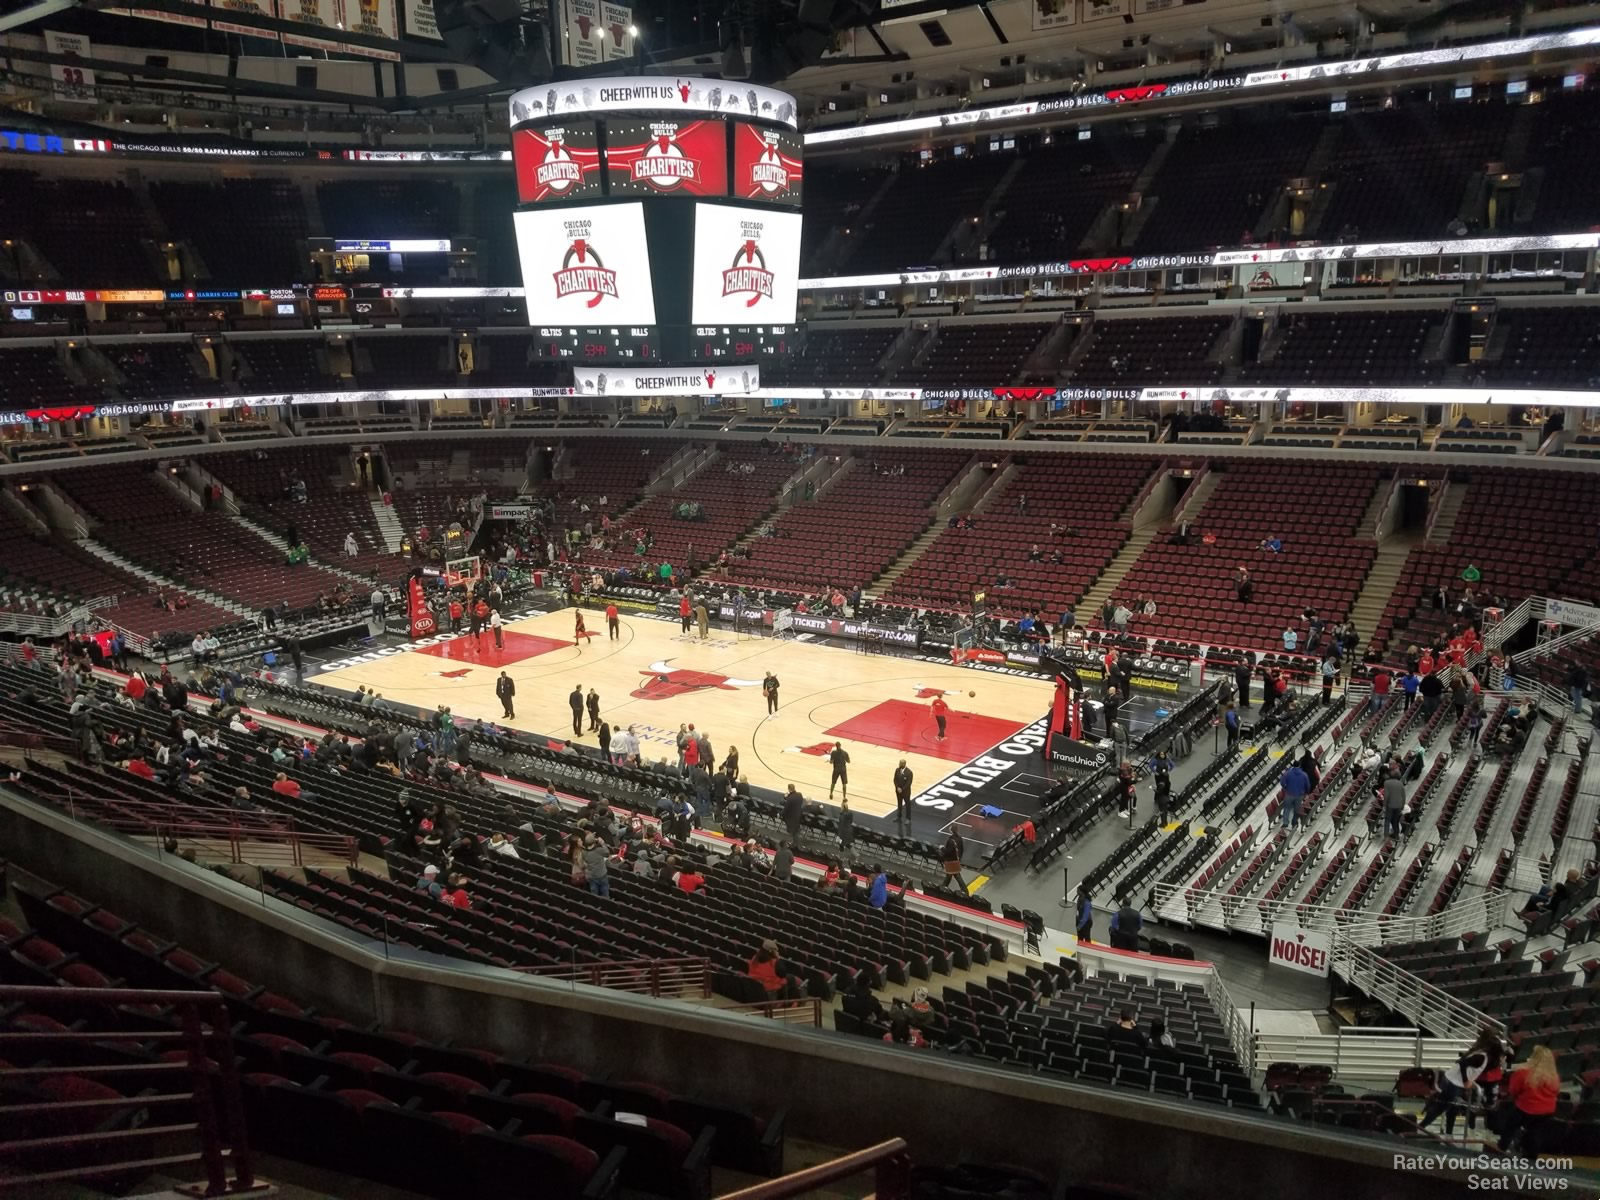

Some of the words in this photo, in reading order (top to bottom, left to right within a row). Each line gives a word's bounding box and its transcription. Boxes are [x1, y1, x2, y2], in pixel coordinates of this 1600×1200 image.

[1172, 81, 1209, 93] CHICAGO
[1212, 77, 1241, 88] BULLS
[600, 87, 632, 102] CHEER
[633, 86, 658, 99] WITH
[660, 86, 673, 99] US
[1040, 100, 1075, 111] CHICAGO
[1077, 95, 1102, 106] BULLS
[127, 144, 160, 152] CHICAGO
[204, 147, 229, 155] RAFFLE
[537, 162, 580, 184] CHARITIES
[635, 158, 694, 178] CHARITIES
[753, 164, 787, 186] CHARITIES
[563, 219, 592, 229] CHICAGO
[740, 220, 764, 231] CHICAGO
[569, 228, 589, 237] BULLS
[743, 229, 759, 238] BULLS
[1137, 256, 1177, 267] CHICAGO
[1180, 255, 1210, 265] BULLS
[1001, 266, 1037, 276] CHICAGO
[1040, 264, 1065, 273] BULLS
[558, 269, 616, 295] CHARITIES
[725, 269, 772, 295] CHARITIES
[66, 291, 86, 301] BULLS
[541, 328, 562, 337] CELTICS
[631, 328, 649, 337] BULLS
[696, 327, 716, 336] CELTICS
[772, 326, 786, 335] BULLS
[635, 377, 665, 390] CHEER
[665, 376, 688, 388] WITH
[690, 375, 702, 387] US
[532, 388, 546, 396] RUN
[546, 388, 559, 396] WITH
[559, 387, 568, 395] US
[925, 390, 960, 399] CHICAGO
[962, 390, 989, 399] BULLS
[1061, 390, 1102, 399] CHICAGO
[1106, 390, 1137, 398] BULLS
[100, 405, 139, 415] CHICAGO
[142, 402, 169, 412] BULLS
[1563, 606, 1598, 619] Advocate
[417, 620, 430, 628] KIA
[794, 617, 826, 629] TICKETS
[1562, 614, 1587, 626] Health
[320, 631, 458, 671] CHICAGO
[1007, 652, 1040, 663] Bulls.com
[1052, 751, 1098, 768] TransUnion
[914, 755, 1017, 811] BULLS
[1272, 937, 1326, 972] NOISE!
